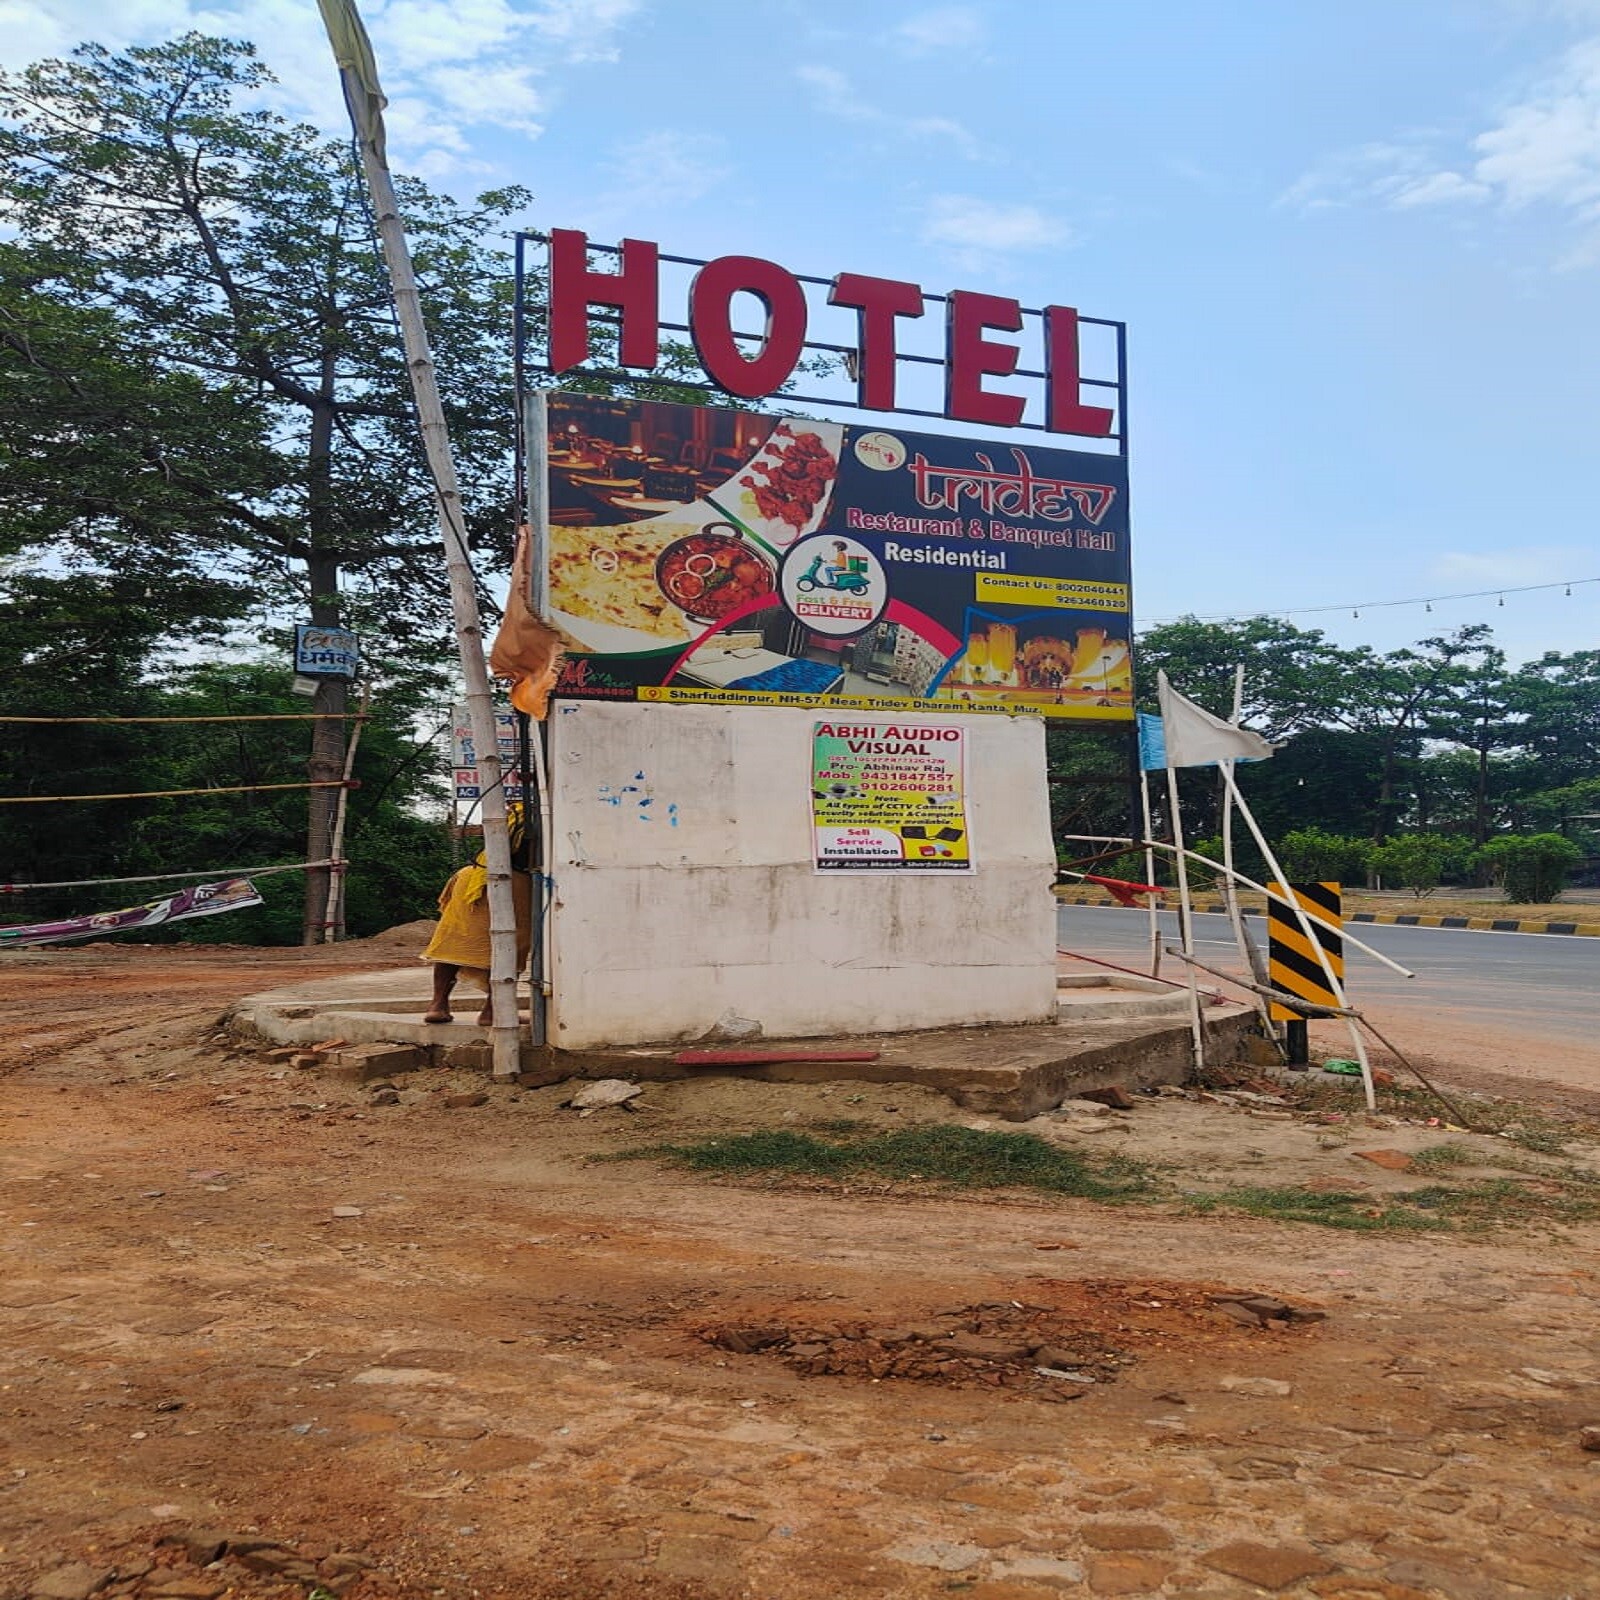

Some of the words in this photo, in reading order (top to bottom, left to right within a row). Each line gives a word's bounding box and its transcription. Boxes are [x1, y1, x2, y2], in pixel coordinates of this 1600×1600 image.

[548, 228, 1114, 436] HOTEL
[908, 448, 1117, 525] tridev
[846, 508, 964, 538] Restaurant
[969, 519, 984, 539] &
[990, 521, 1073, 549] Banquet
[1075, 529, 1115, 550] Hall
[884, 542, 1006, 569] Residential
[983, 577, 1029, 588] Contact
[799, 604, 870, 618] DELIVERY
[669, 690, 774, 703] Sharfuddinpur,
[830, 697, 862, 706] Near
[867, 698, 908, 708] Tridev
[913, 701, 963, 710] Dharam
[816, 724, 875, 739] ABHI
[883, 727, 959, 741] AUDIO
[847, 741, 930, 755] VISUAL
[924, 765, 945, 773] Raj
[824, 847, 898, 855] Installation
